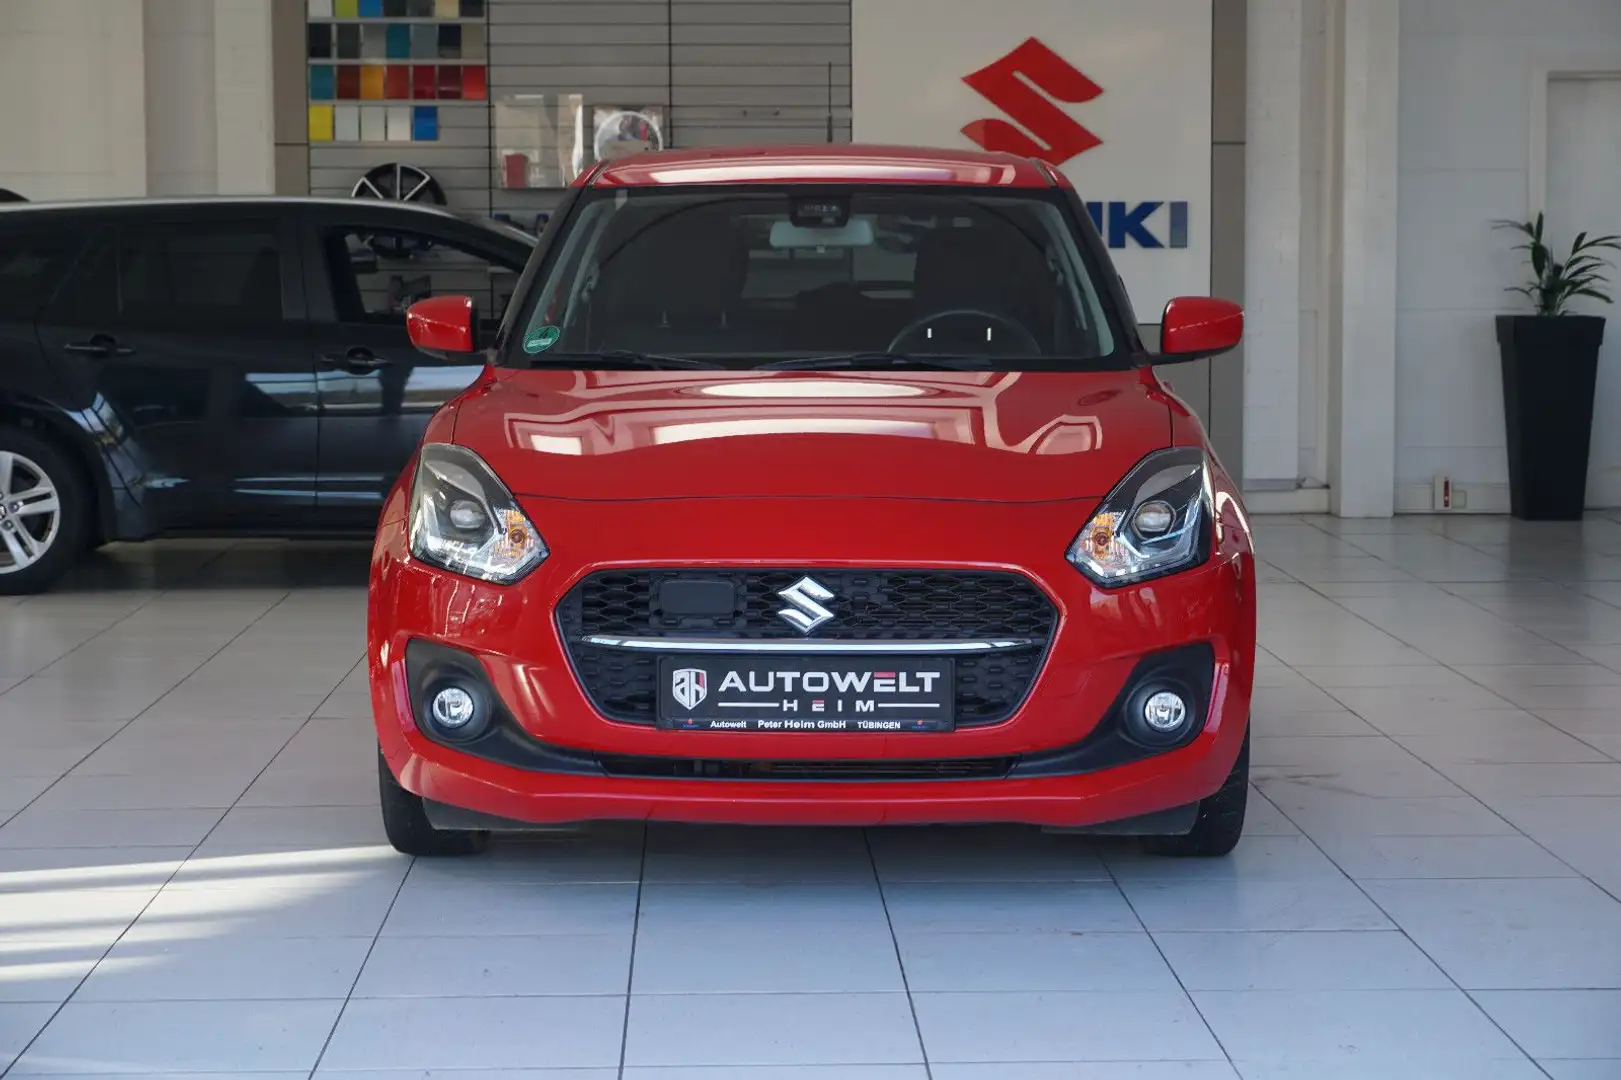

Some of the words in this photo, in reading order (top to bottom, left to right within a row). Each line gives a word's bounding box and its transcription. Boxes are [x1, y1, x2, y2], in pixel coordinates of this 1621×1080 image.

[718, 670, 941, 692] AUTOWELT
[782, 699, 875, 712] HEIM
[709, 720, 747, 729] Autowelt
[757, 719, 783, 729] Peter
[784, 719, 815, 729] Heim
[817, 719, 846, 729] GmbH
[857, 720, 901, 730] TÜBINGEN
